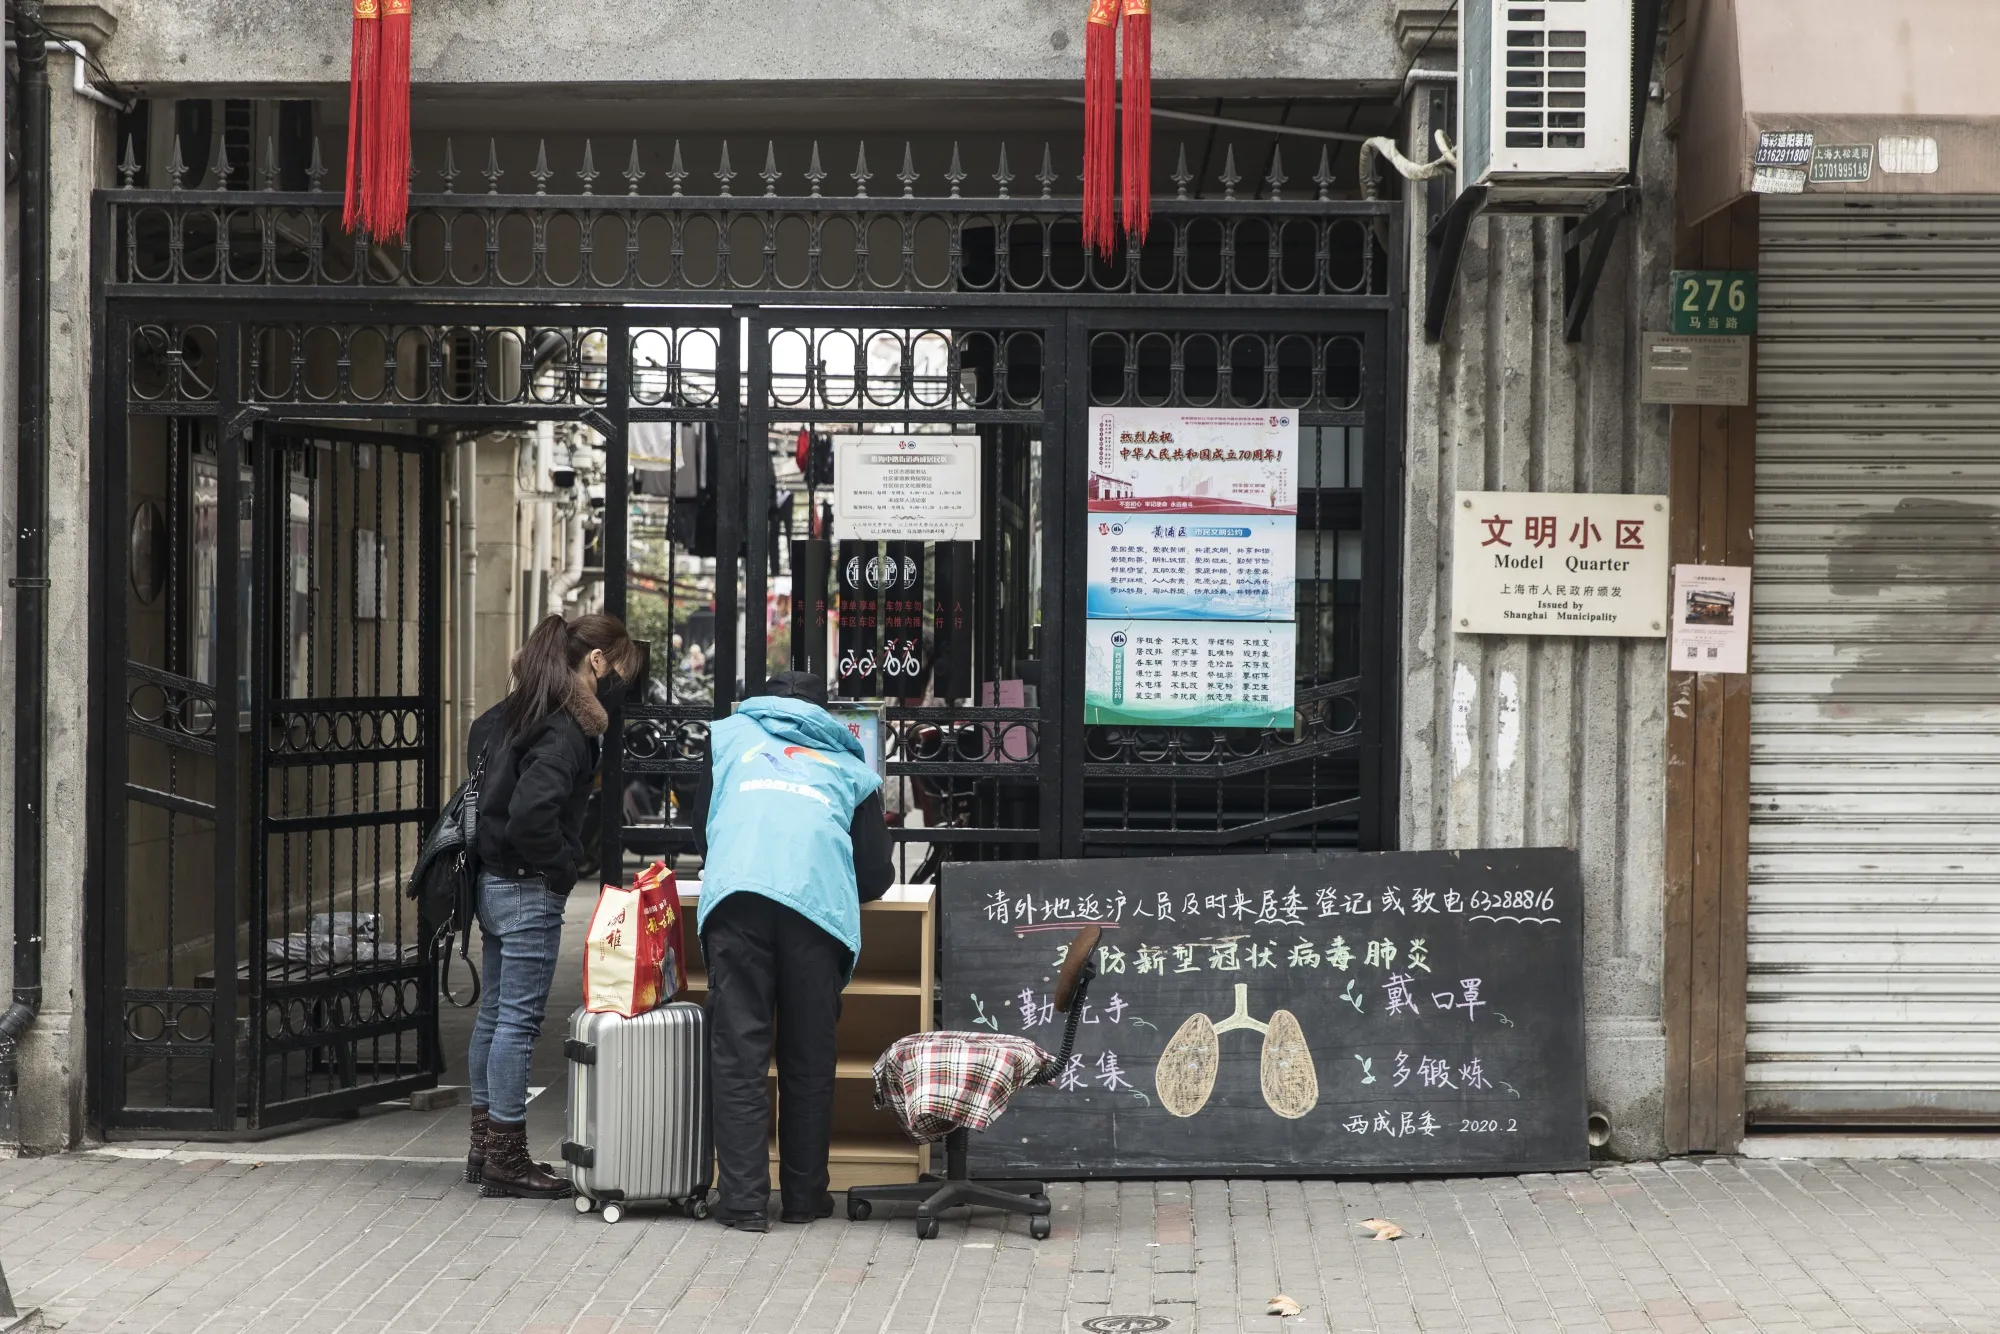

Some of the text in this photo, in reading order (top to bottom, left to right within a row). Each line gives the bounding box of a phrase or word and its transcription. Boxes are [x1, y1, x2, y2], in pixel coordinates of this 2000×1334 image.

[1757, 149, 1809, 162] 13162911800
[1814, 163, 1868, 178] 13701995148
[1682, 279, 1745, 312] 276
[1689, 316, 1738, 329] 马当路
[1120, 431, 1174, 444] 热烈庆祝
[1151, 526, 1187, 538] 黄浦区
[1480, 514, 1645, 550] 文明小区
[1494, 554, 1630, 572] Model Quarter
[1500, 583, 1623, 598] 上海市人民政府颁发
[1538, 601, 1584, 611] Issued by
[1504, 610, 1617, 623] Shanghai Municipality
[1382, 972, 1486, 1021] 戴口罩
[1392, 1050, 1492, 1089] 多锻炼
[1343, 1110, 1517, 1137] 西成居委 2020.2
